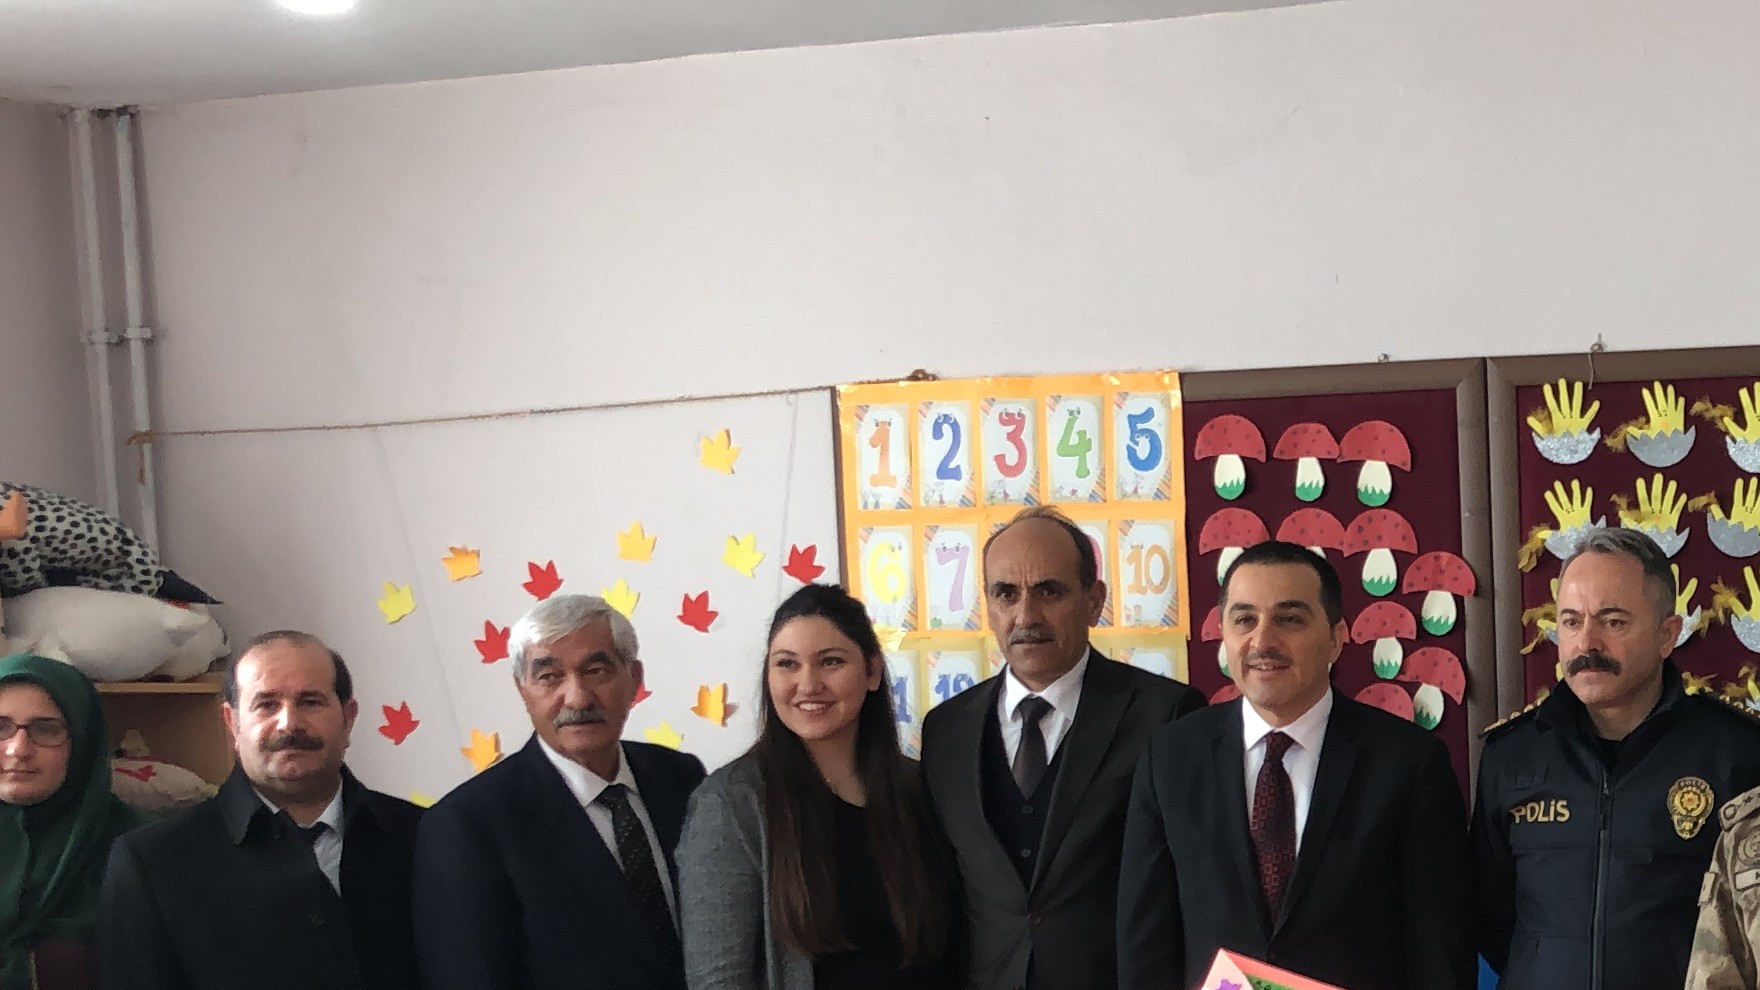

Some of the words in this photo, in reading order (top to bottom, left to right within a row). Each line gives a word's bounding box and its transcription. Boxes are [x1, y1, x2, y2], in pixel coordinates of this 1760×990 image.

[868, 420, 898, 488] 1
[931, 412, 963, 482] 2
[993, 408, 1029, 479] 3
[1056, 408, 1093, 479] 4
[1125, 406, 1164, 473] 5
[867, 541, 907, 604] 6
[935, 545, 970, 613] 7
[1126, 544, 1171, 596] 10
